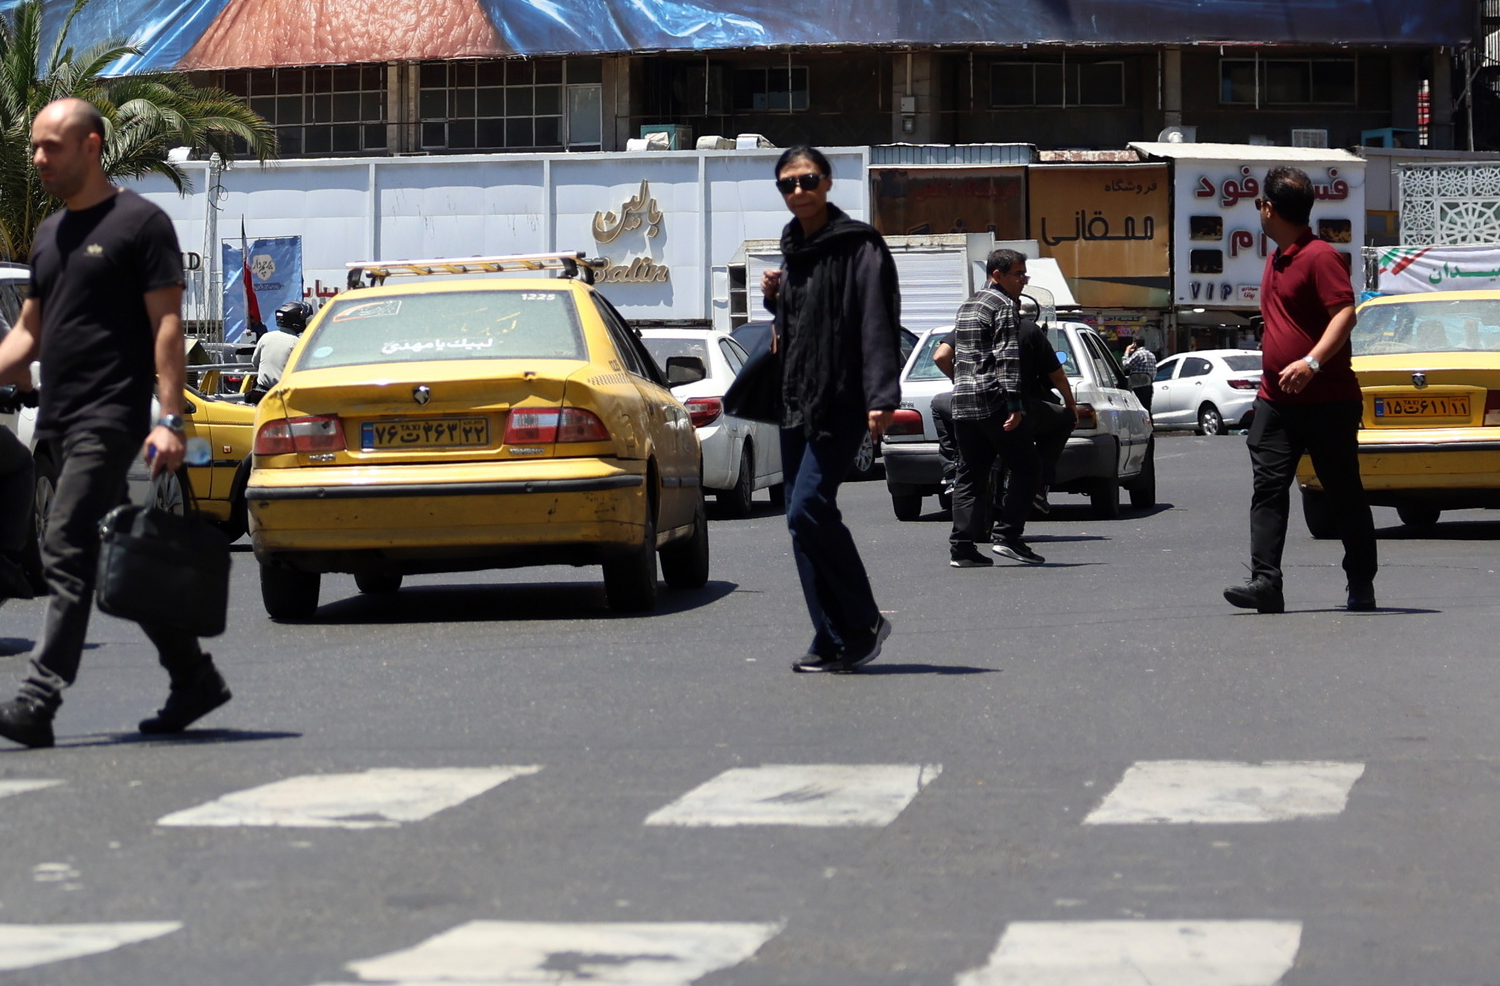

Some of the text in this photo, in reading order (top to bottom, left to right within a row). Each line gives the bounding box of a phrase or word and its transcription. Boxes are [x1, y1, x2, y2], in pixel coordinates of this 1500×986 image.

[1104, 178, 1158, 195] فروشگاه
[1196, 165, 1349, 207] فس فود
[592, 178, 664, 244] بالین
[521, 293, 556, 301] 1225
[1190, 282, 1233, 300] VIP
[401, 424, 421, 432] TAXI
